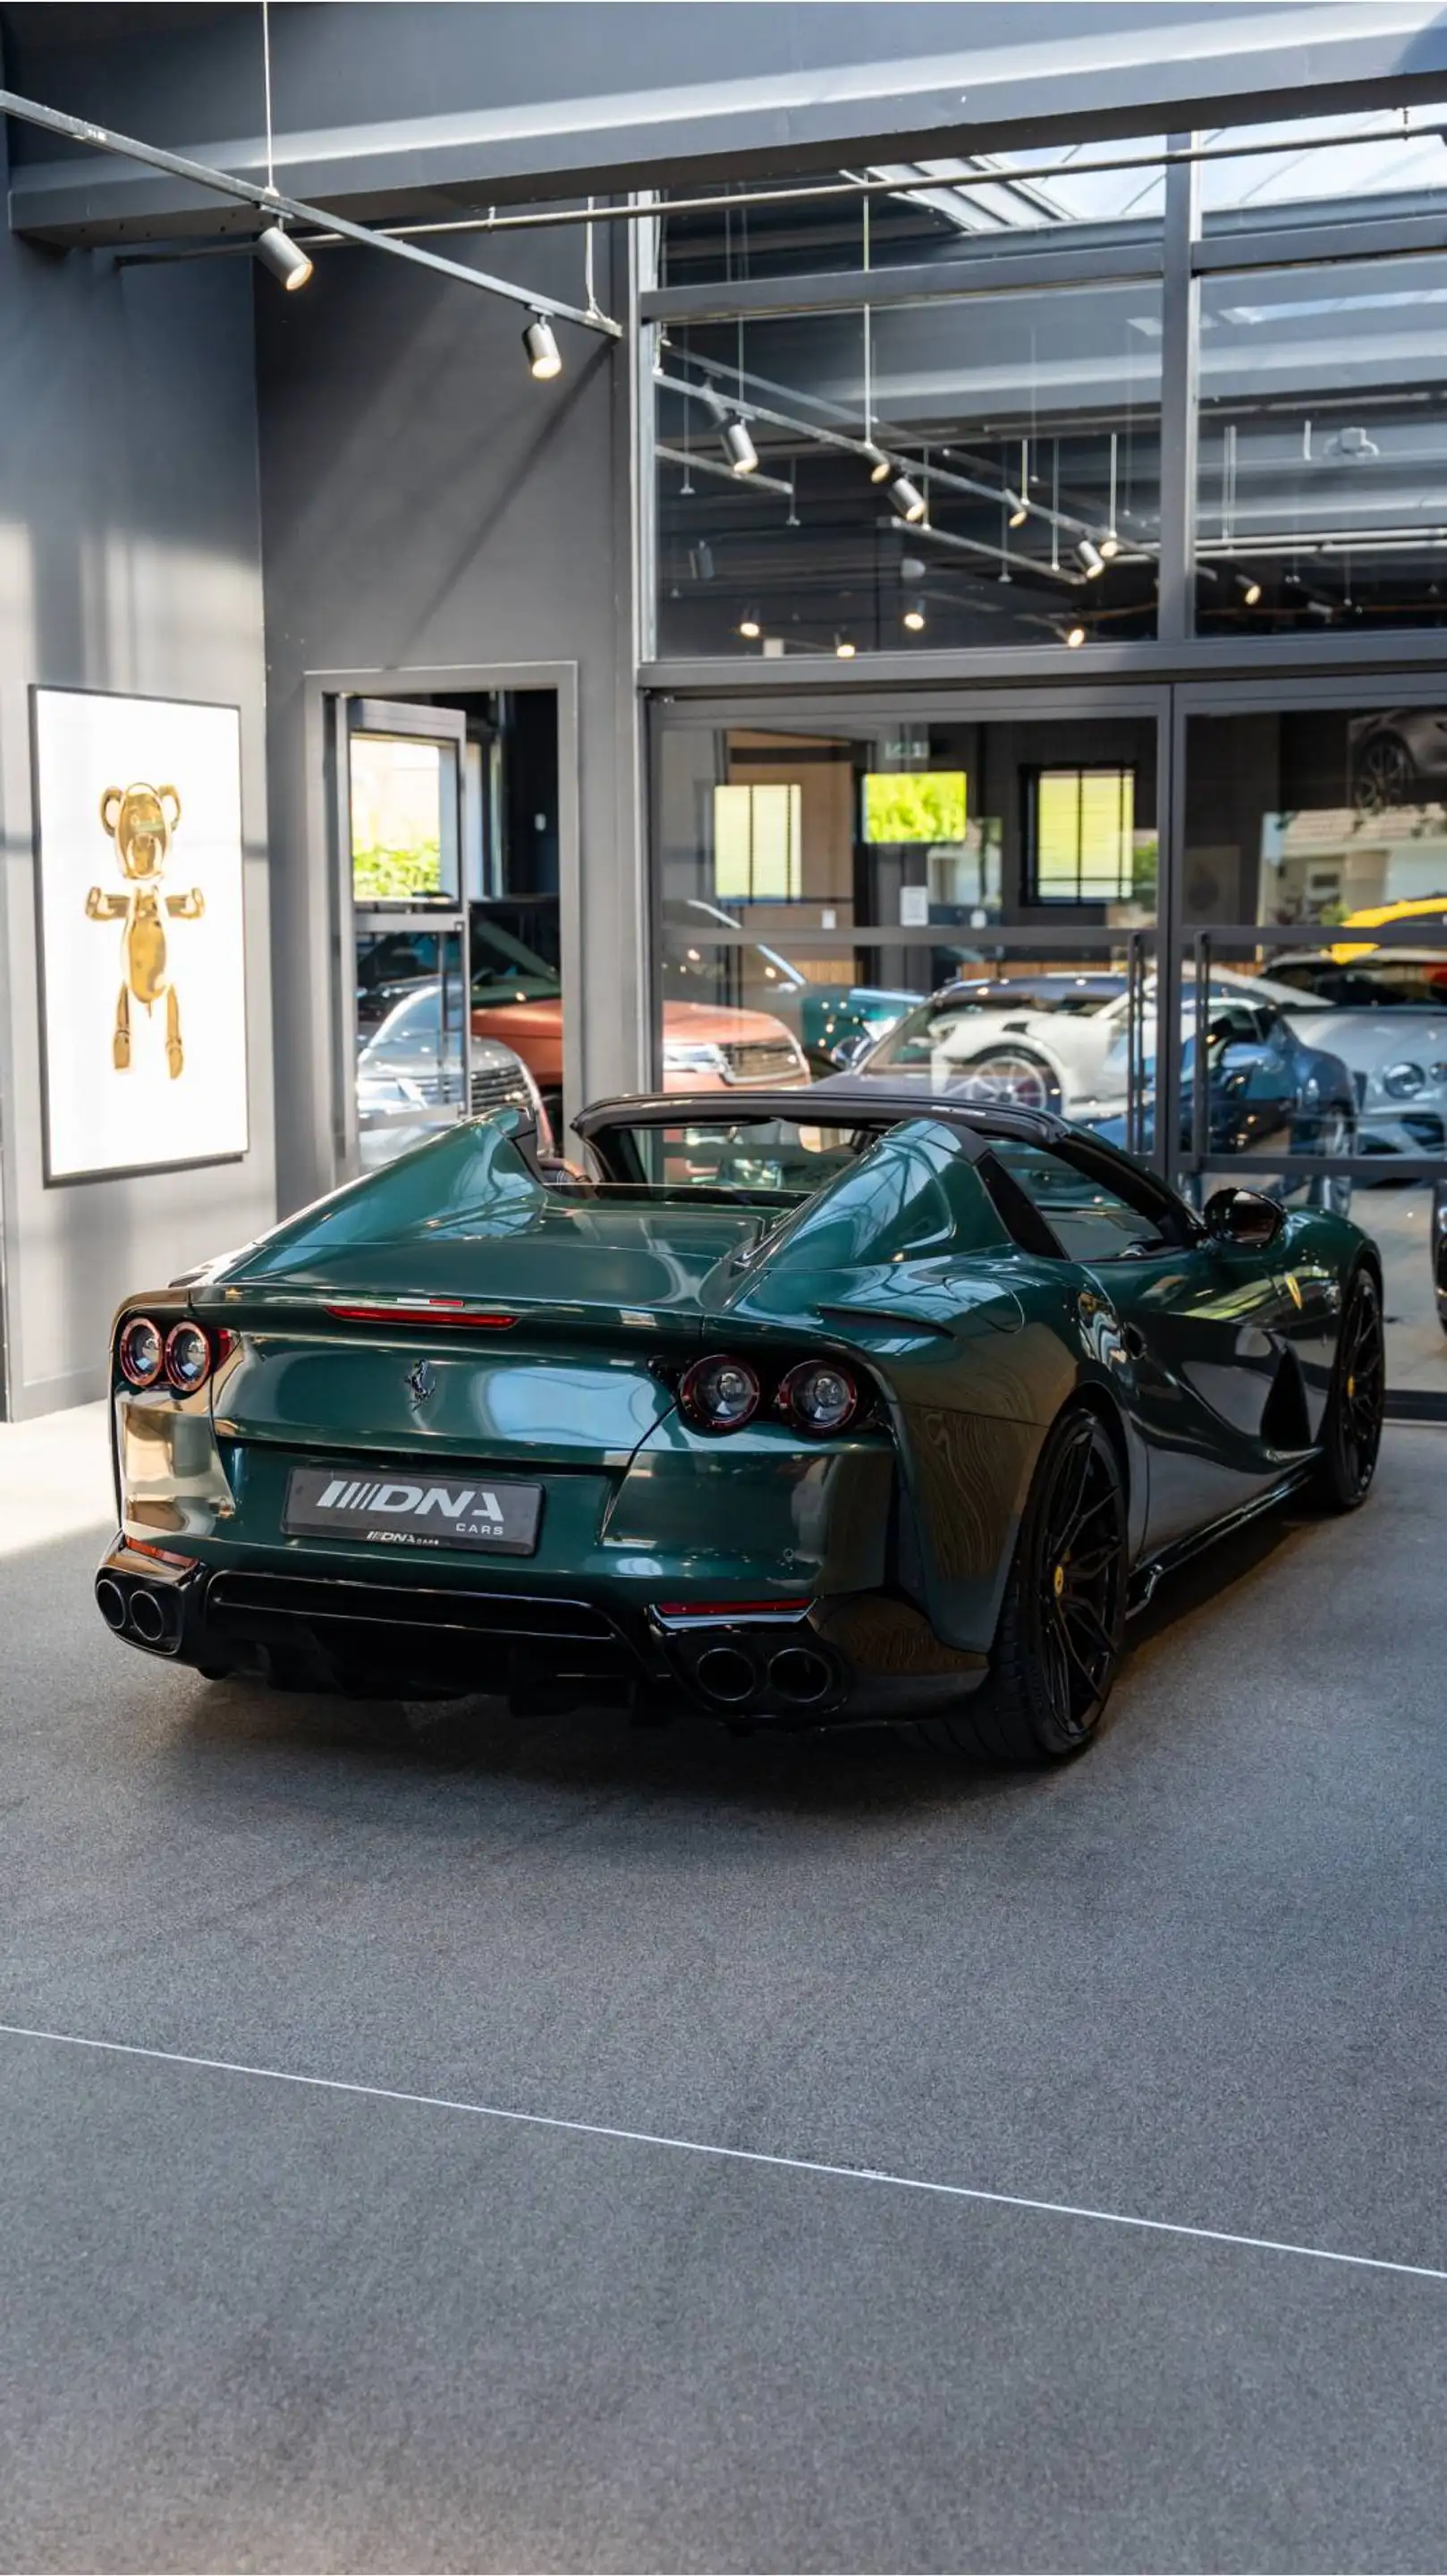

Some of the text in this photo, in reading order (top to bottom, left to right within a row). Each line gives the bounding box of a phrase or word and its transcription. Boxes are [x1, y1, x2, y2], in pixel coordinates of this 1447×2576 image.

[367, 1484, 504, 1521] DNA
[455, 1522, 504, 1536] CARS
[380, 1531, 416, 1544] DNA
